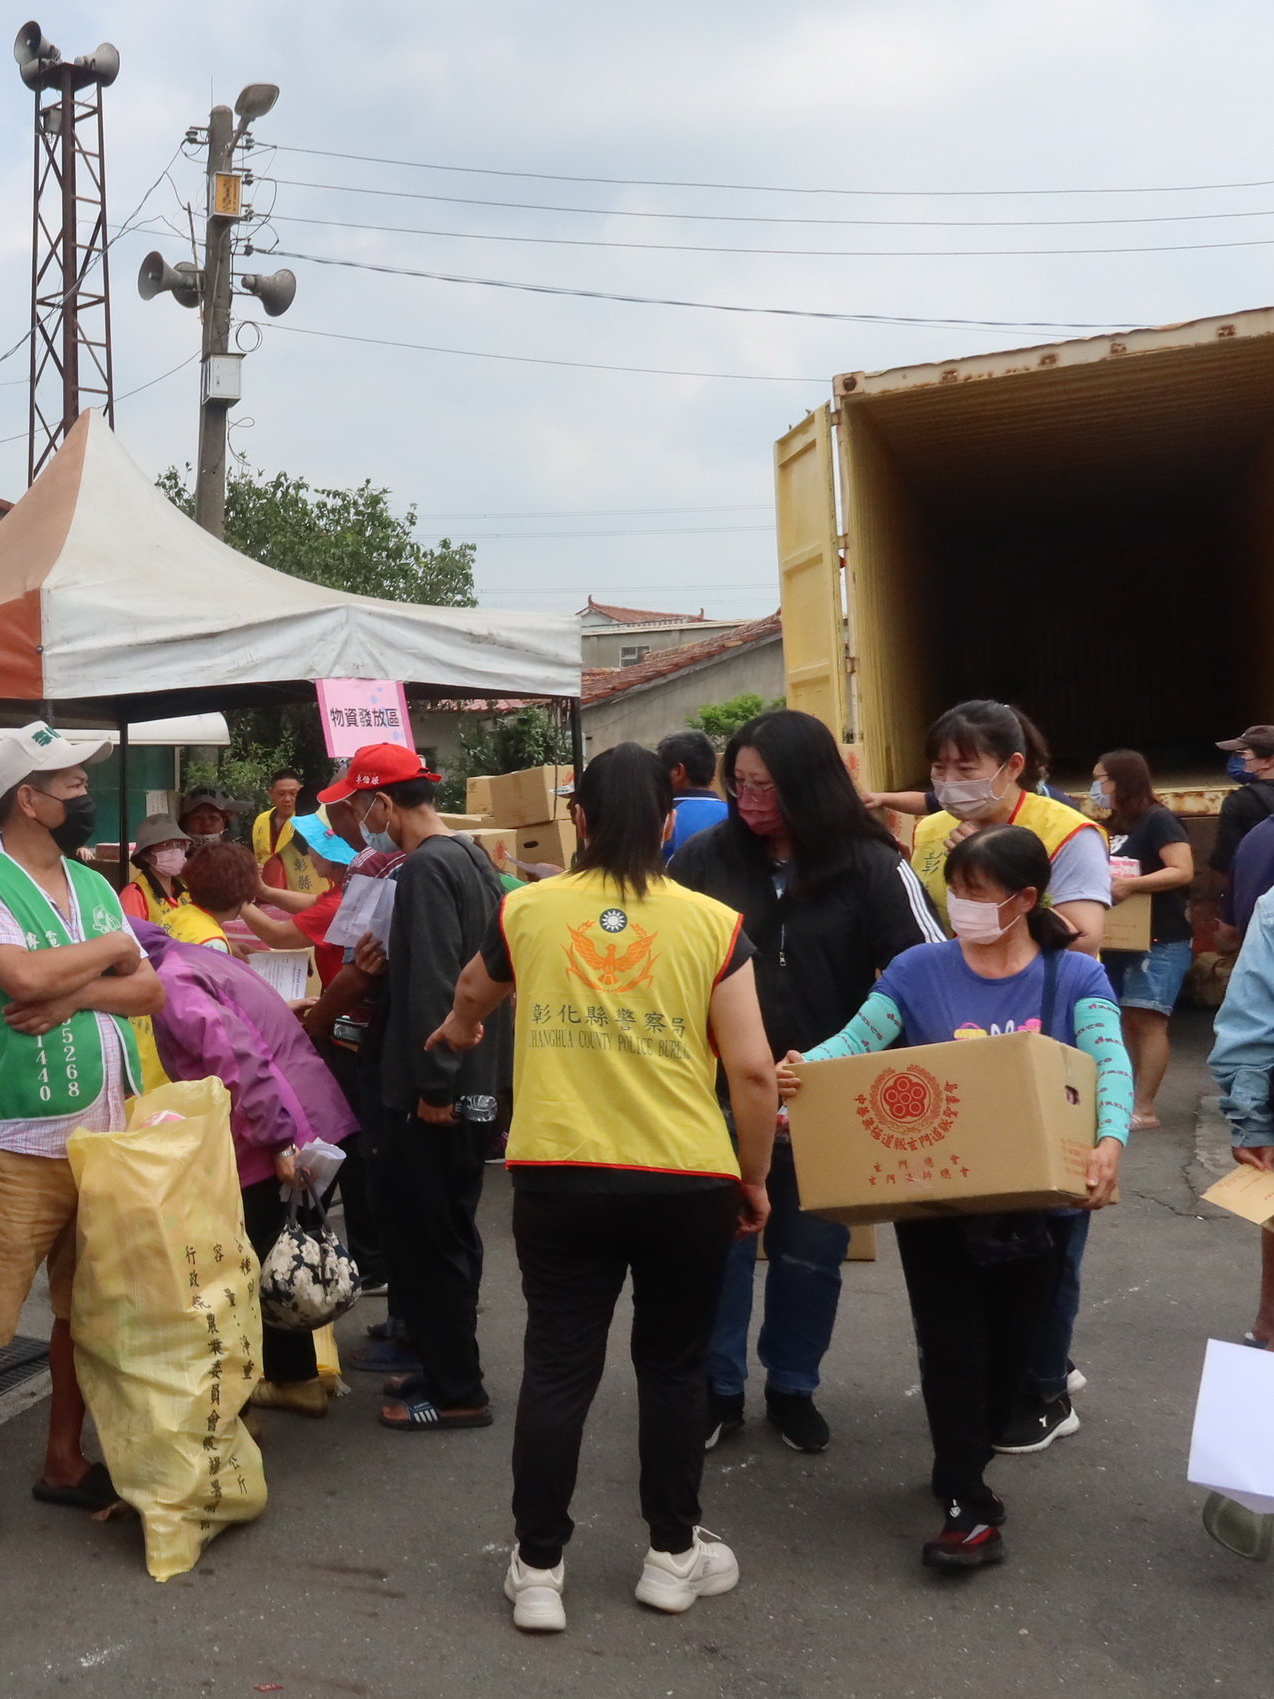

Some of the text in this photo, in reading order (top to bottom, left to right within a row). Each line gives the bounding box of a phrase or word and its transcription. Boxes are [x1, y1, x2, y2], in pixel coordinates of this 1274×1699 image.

[330, 707, 400, 728] 物資發放區
[531, 1003, 686, 1039] 彰化縣警察局
[578, 1030, 614, 1051] COUNTY
[618, 1034, 653, 1056] POLICE
